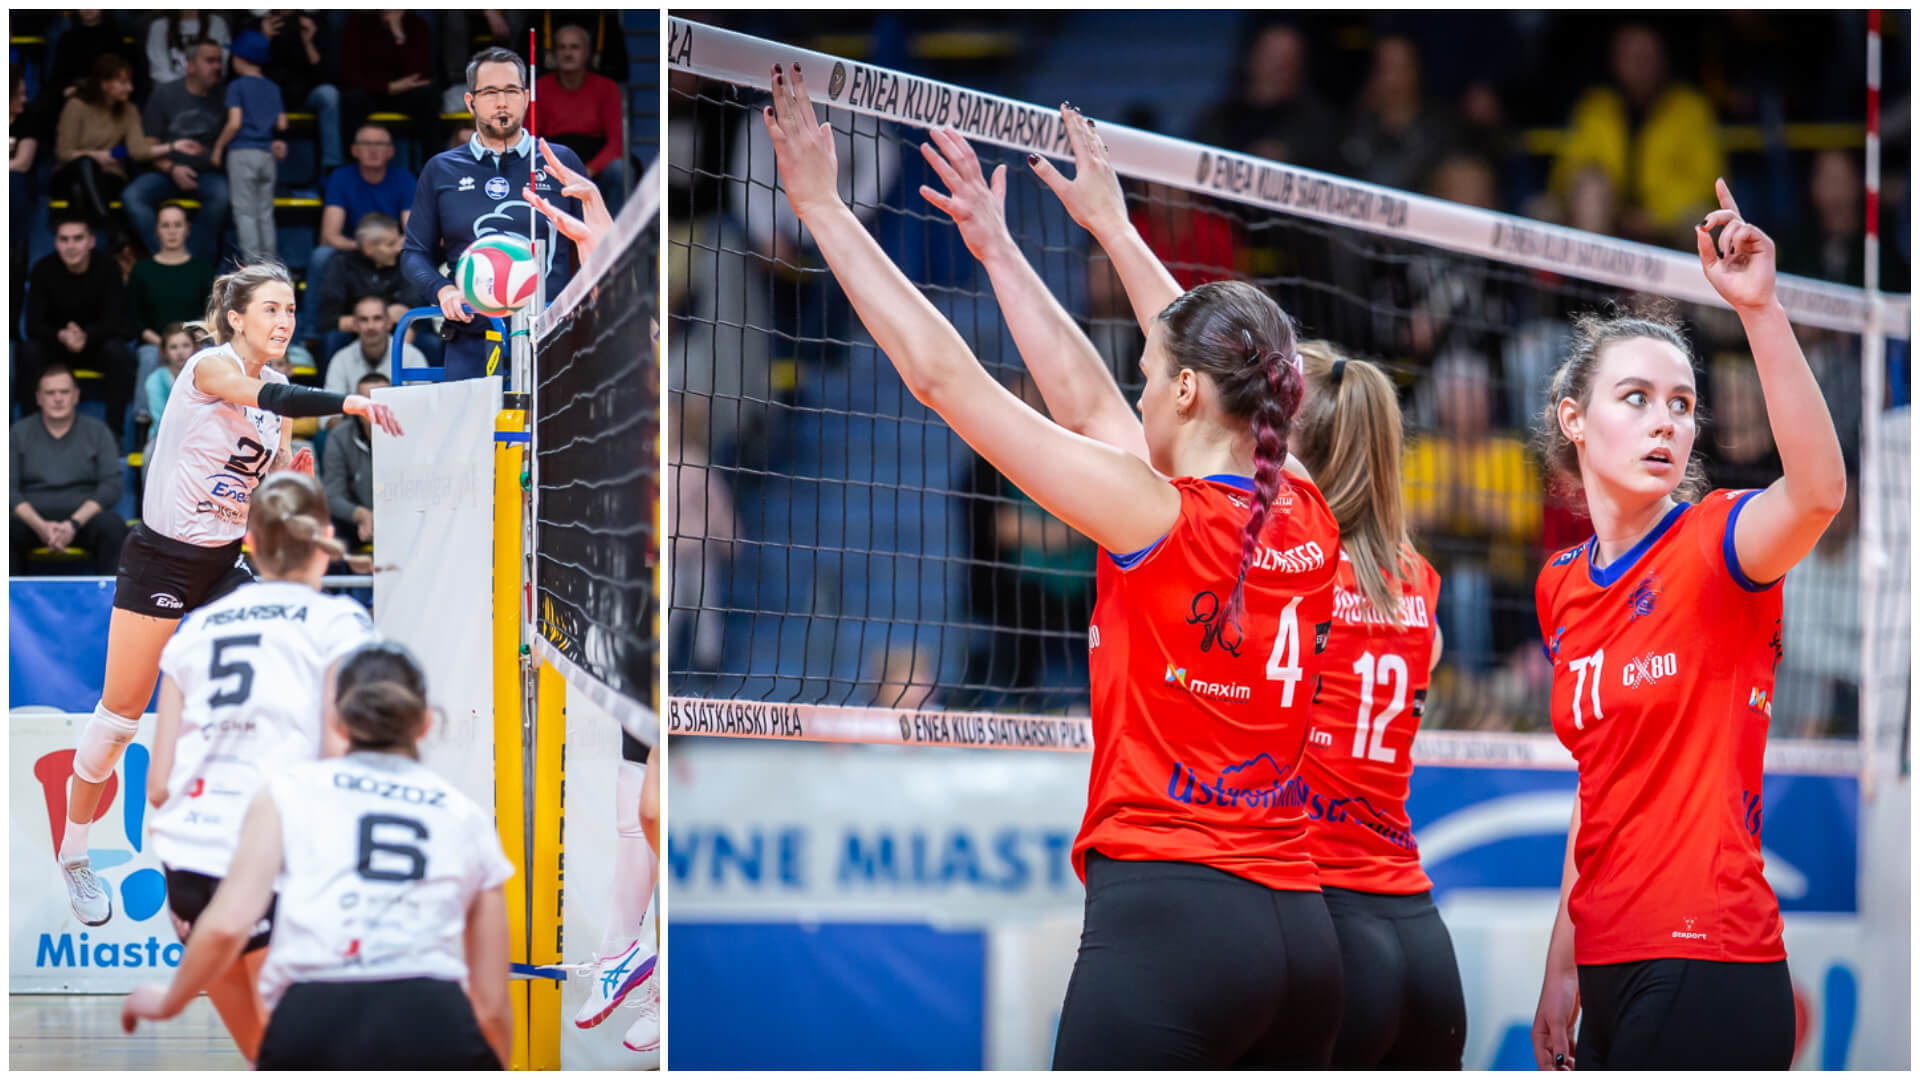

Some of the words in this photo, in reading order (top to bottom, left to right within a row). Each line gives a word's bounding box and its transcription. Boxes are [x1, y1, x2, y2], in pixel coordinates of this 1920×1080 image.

[848, 65, 899, 115] ENEA
[902, 79, 952, 126] KLUB
[953, 91, 1053, 149] SIATKARSKI
[211, 482, 248, 503] Ene
[208, 633, 262, 709] 5
[1266, 596, 1304, 708] 4
[685, 701, 768, 735] SIATKARSKI
[771, 706, 803, 737] PIŁA
[1190, 679, 1250, 699] maxim
[1352, 651, 1408, 764] 12
[1569, 648, 1604, 730] 71
[1623, 651, 1677, 689] CX80
[914, 714, 950, 743] ENEA
[951, 716, 986, 744] KLUB
[988, 718, 1058, 747] SIATKARSKI
[357, 813, 429, 883] 6
[36, 932, 185, 968] Miasto
